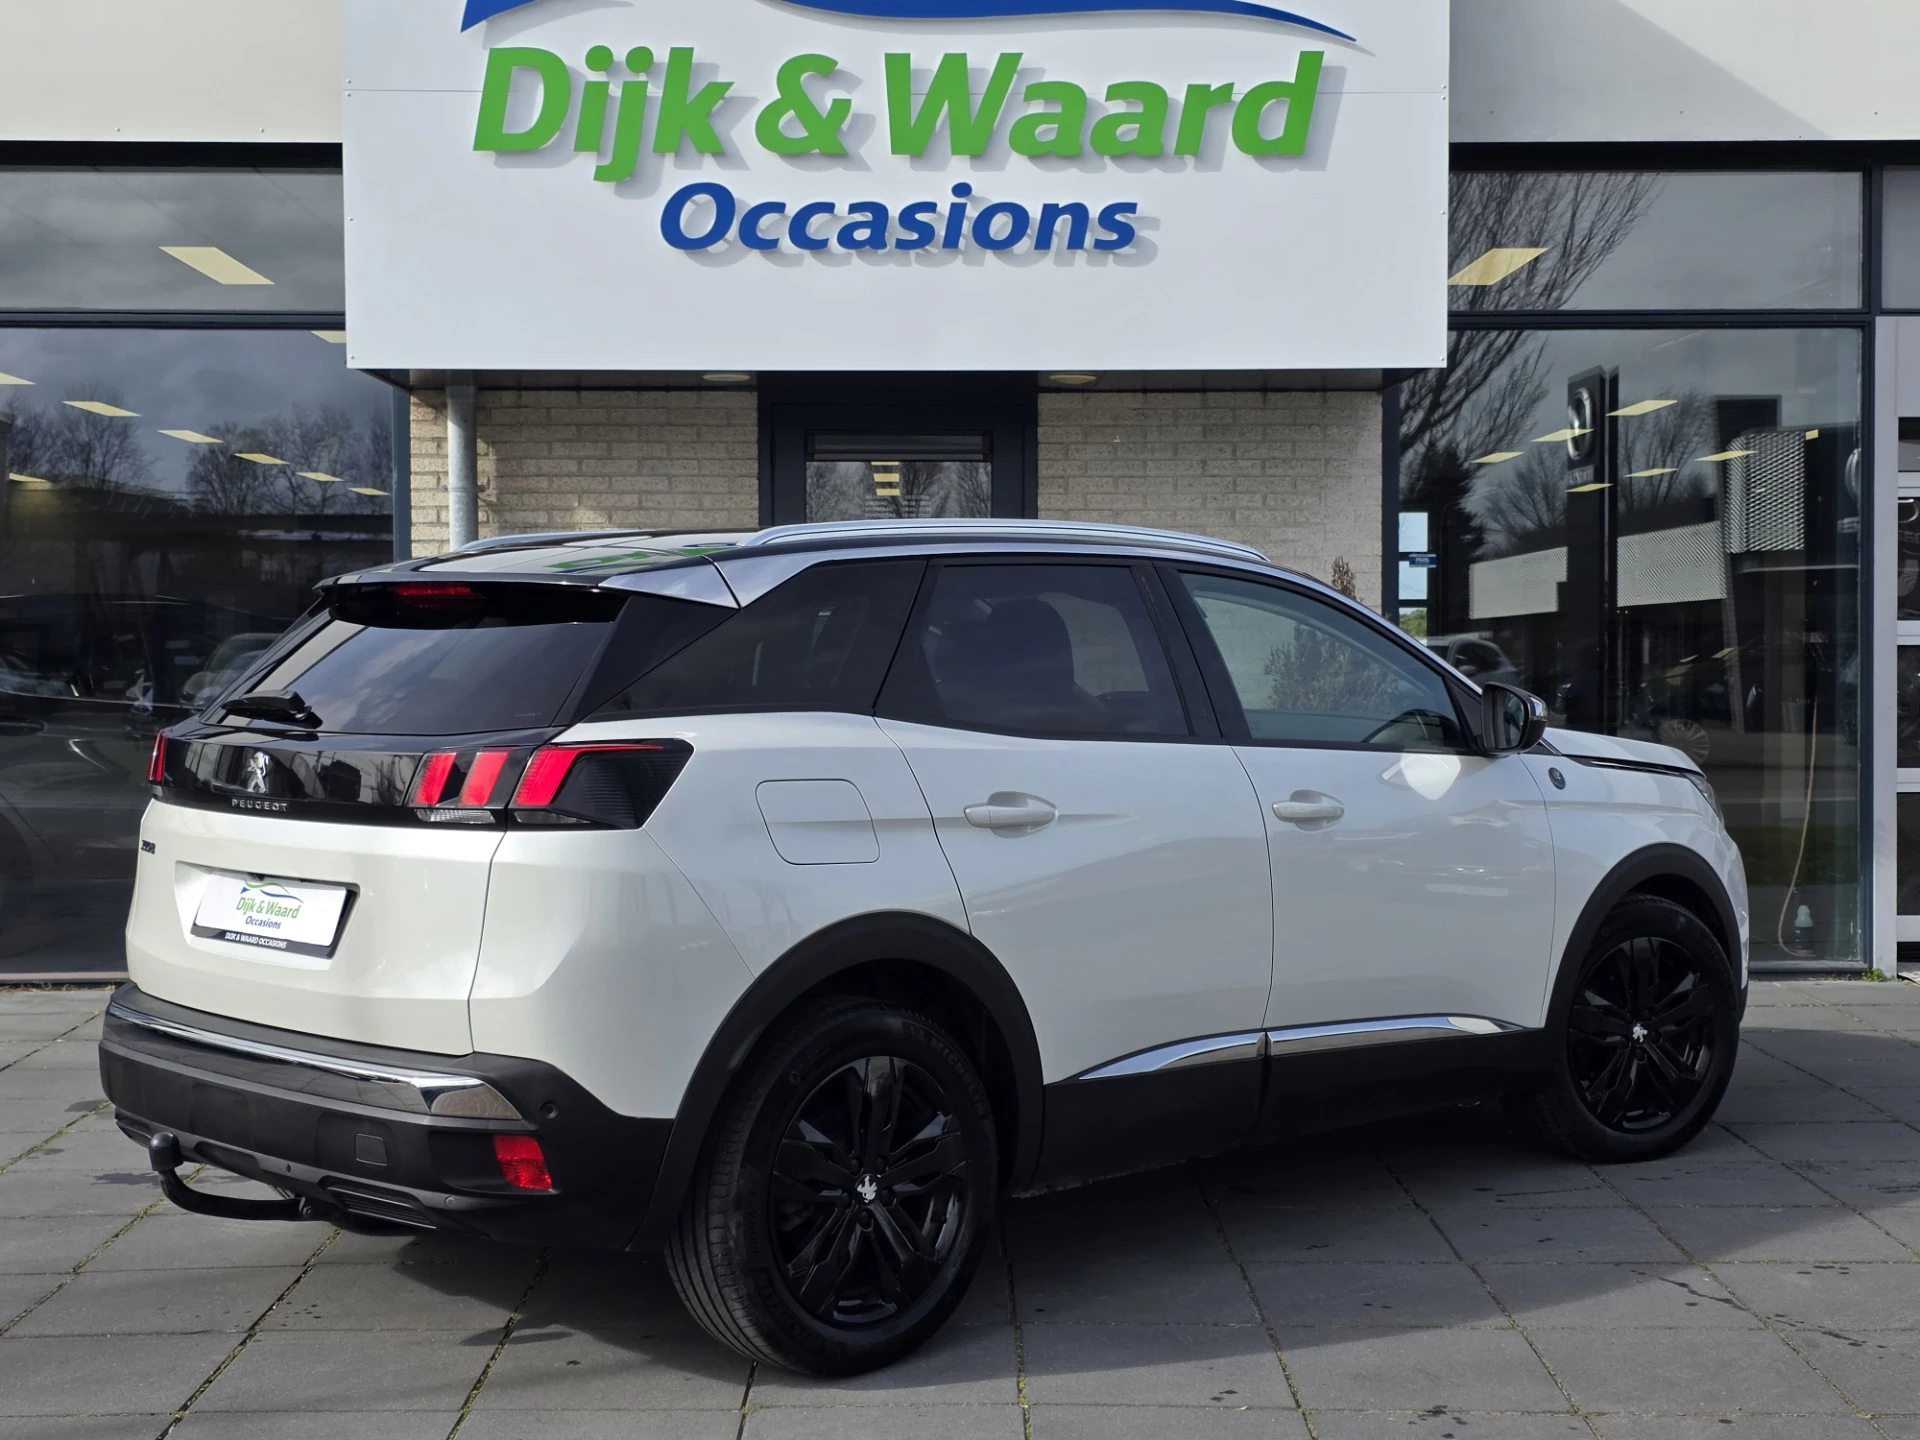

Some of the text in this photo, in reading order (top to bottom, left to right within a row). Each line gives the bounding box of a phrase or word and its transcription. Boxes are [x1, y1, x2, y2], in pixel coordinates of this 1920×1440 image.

[474, 45, 1324, 182] Dijk & Waard
[660, 182, 1138, 251] Occasions
[231, 799, 288, 811] PEUGEOT
[236, 897, 301, 918] Dijk & Waard
[245, 916, 281, 929] Occasions
